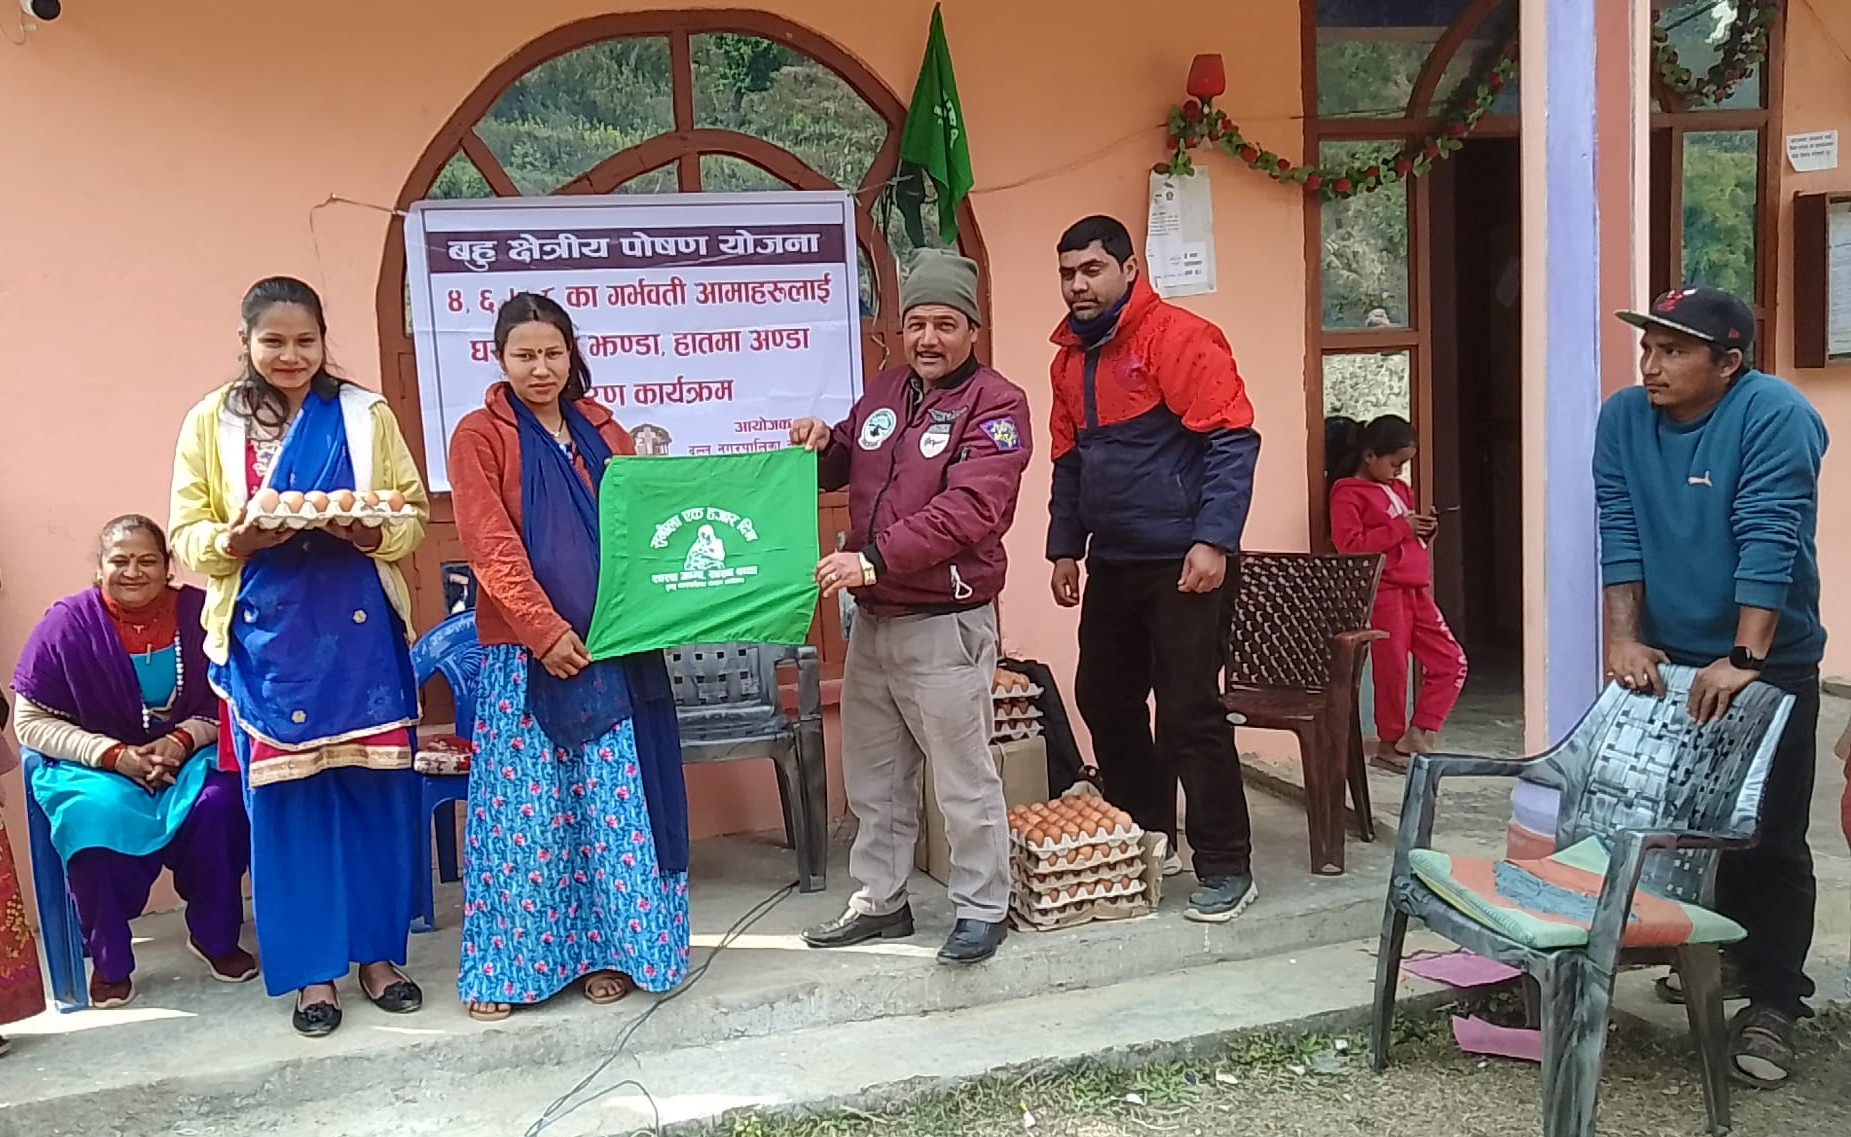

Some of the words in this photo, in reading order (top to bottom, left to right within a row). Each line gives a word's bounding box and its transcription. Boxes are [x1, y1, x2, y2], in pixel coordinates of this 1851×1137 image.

[447, 240, 498, 271] बहु
[507, 233, 610, 264] क्षेत्रीय
[620, 231, 709, 257] पोषण
[718, 229, 821, 255] योजना
[565, 285, 599, 307] का
[606, 275, 687, 307] गर्भवती
[673, 330, 742, 357] हातमा
[748, 328, 810, 351] अण्डा
[633, 375, 734, 405] कार्यक्रम
